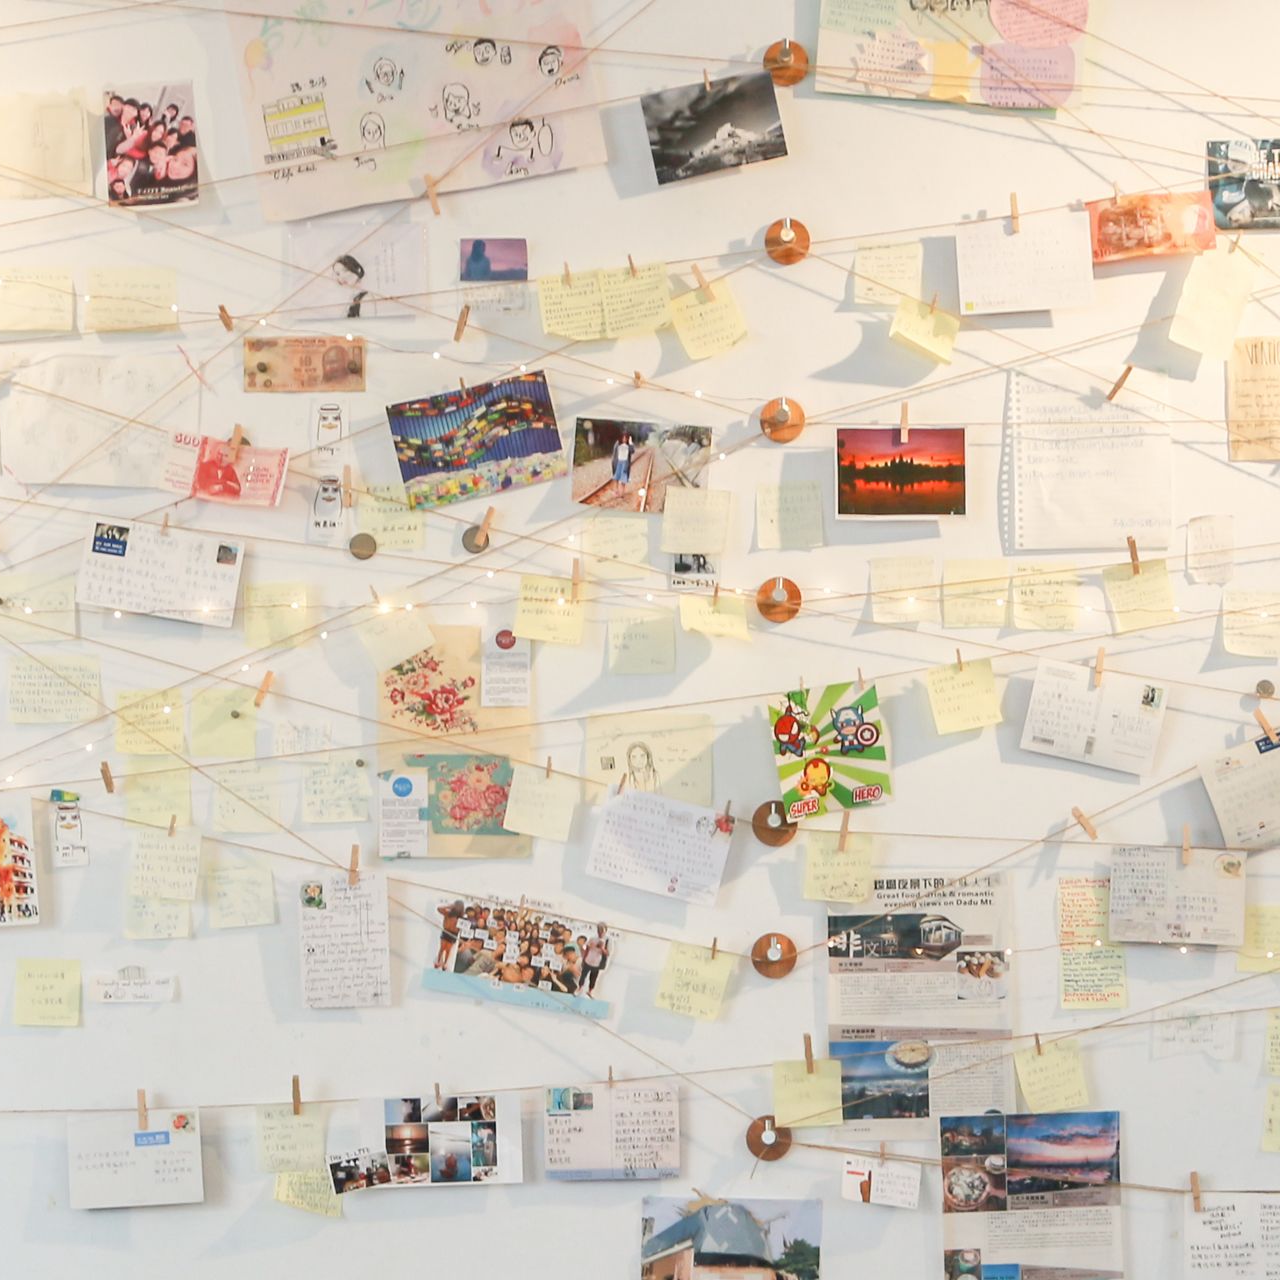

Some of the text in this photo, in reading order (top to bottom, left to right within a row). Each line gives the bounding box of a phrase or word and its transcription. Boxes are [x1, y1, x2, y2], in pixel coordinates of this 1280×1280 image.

[854, 785, 882, 802] HERO
[790, 798, 819, 817] SUPER
[876, 892, 899, 900] Great
[957, 890, 995, 898] romantic
[956, 898, 979, 906] Dadu
